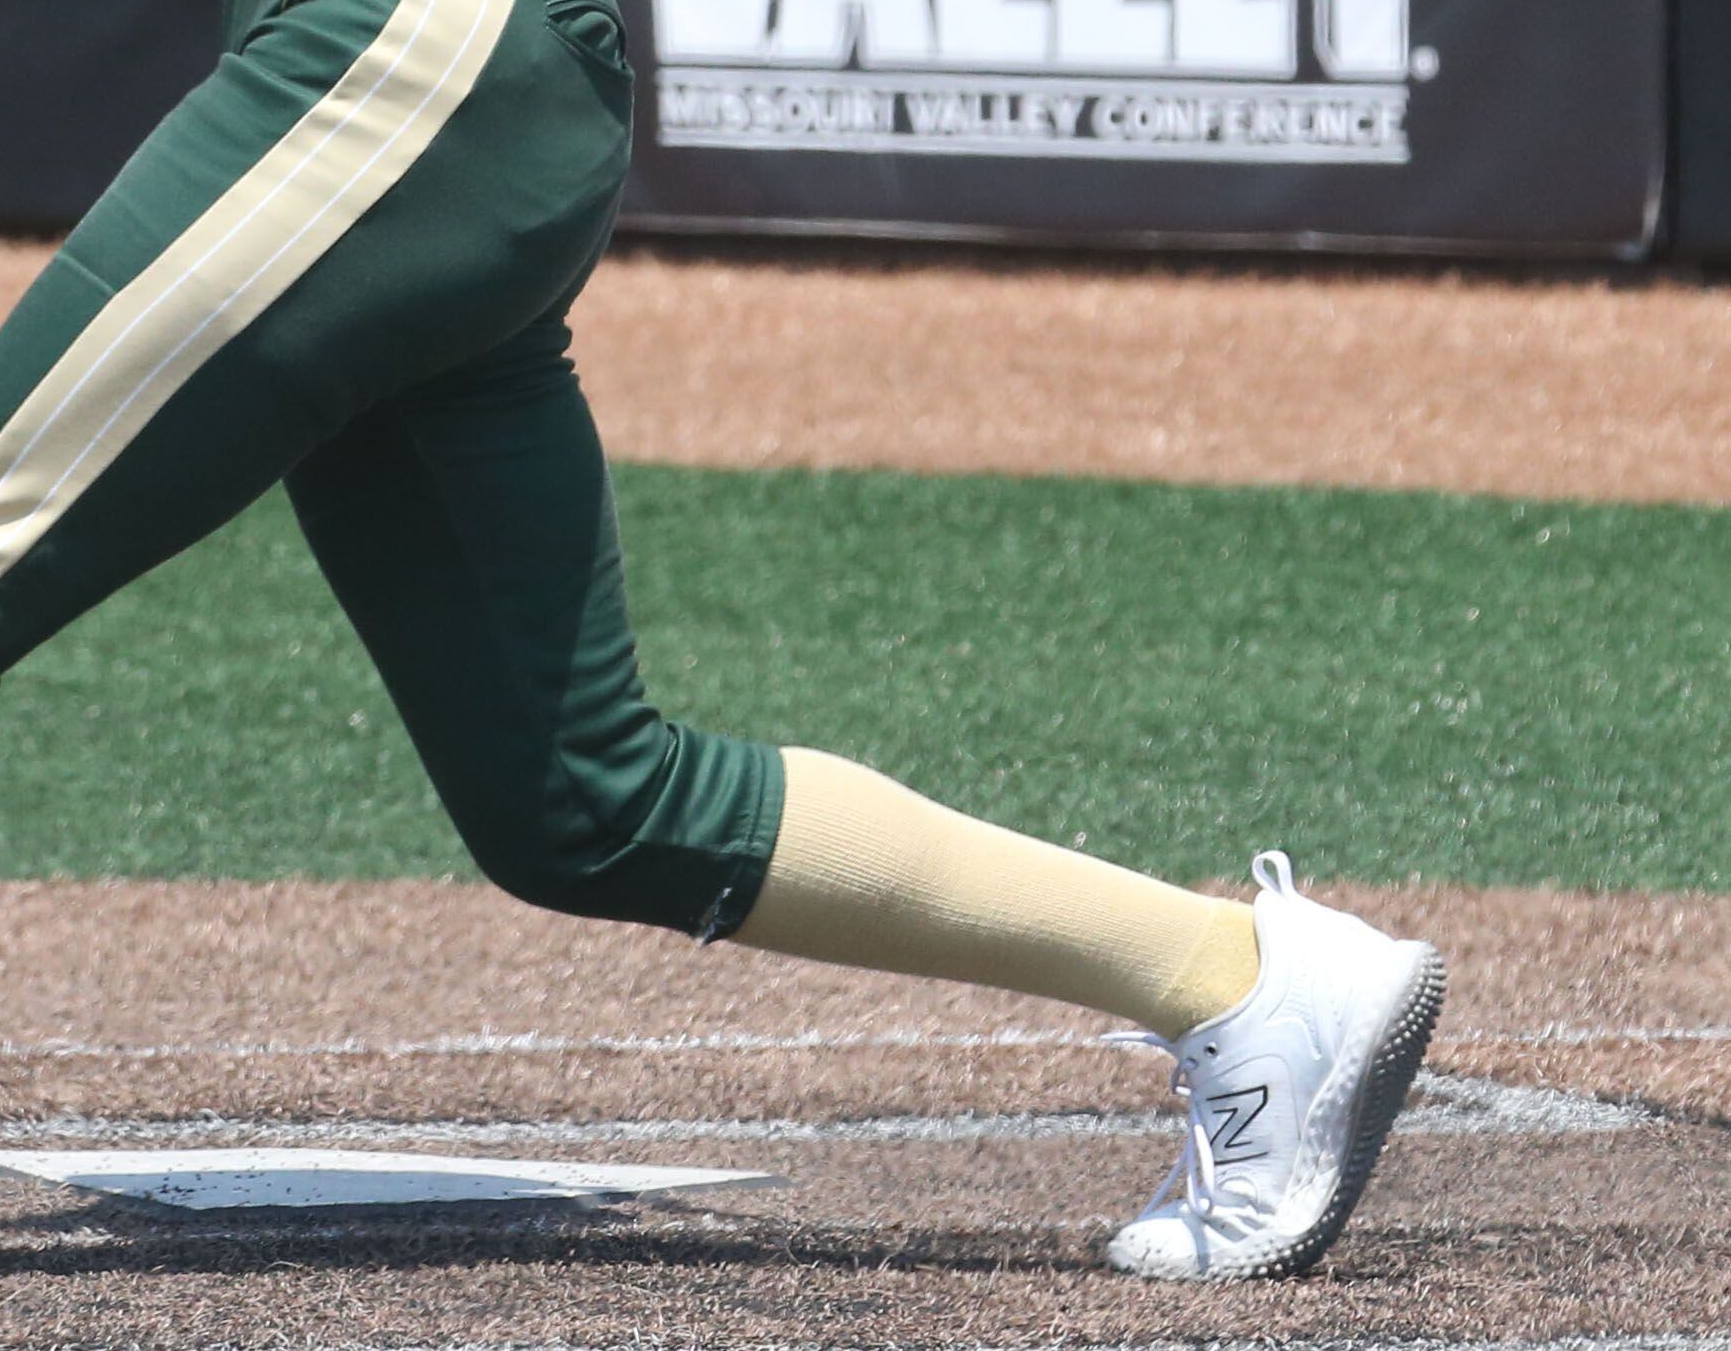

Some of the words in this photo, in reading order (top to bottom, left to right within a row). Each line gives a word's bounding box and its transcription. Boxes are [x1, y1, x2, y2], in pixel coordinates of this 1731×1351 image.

[662, 85, 895, 134] MISSOURI
[905, 91, 1078, 142] VALLEY
[1089, 95, 1406, 147] CONFERENCE
